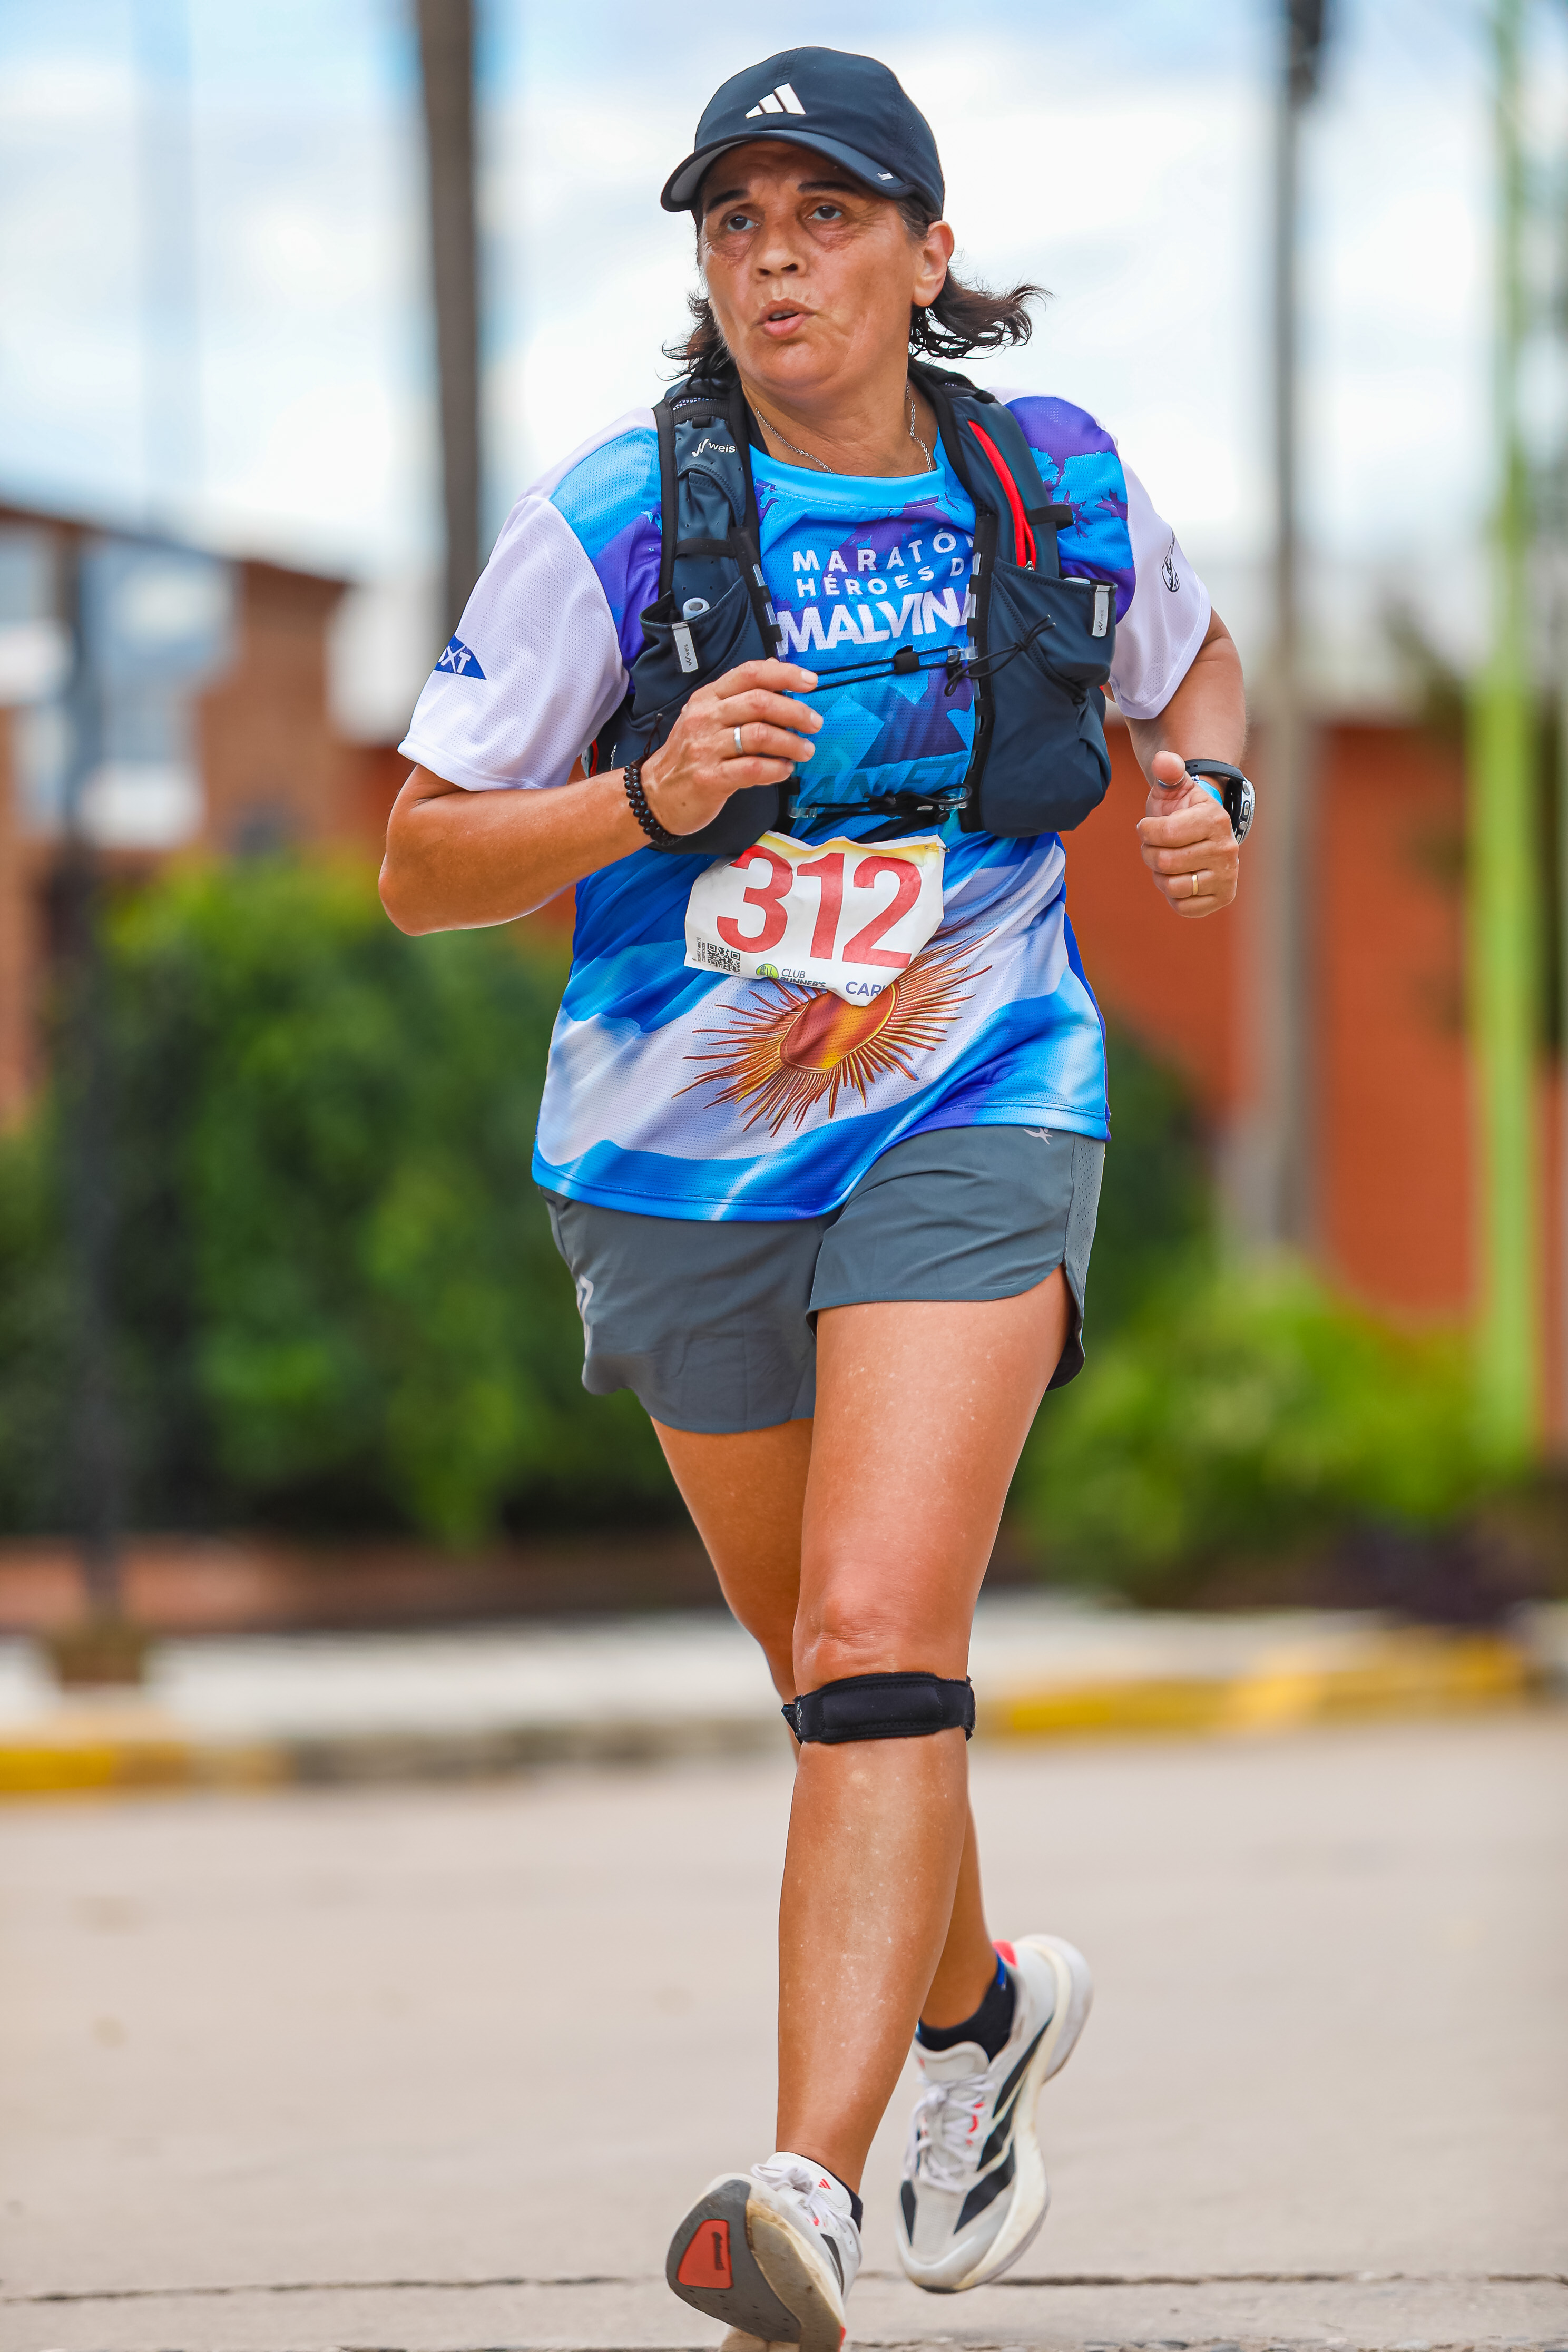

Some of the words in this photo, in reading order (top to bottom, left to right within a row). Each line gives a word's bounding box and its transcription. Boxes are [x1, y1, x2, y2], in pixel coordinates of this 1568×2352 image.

[709, 442, 736, 453] weis
[798, 565, 935, 597] HÉROES
[438, 644, 471, 674] XT
[717, 844, 922, 969] 312
[781, 968, 806, 979] CLUB
